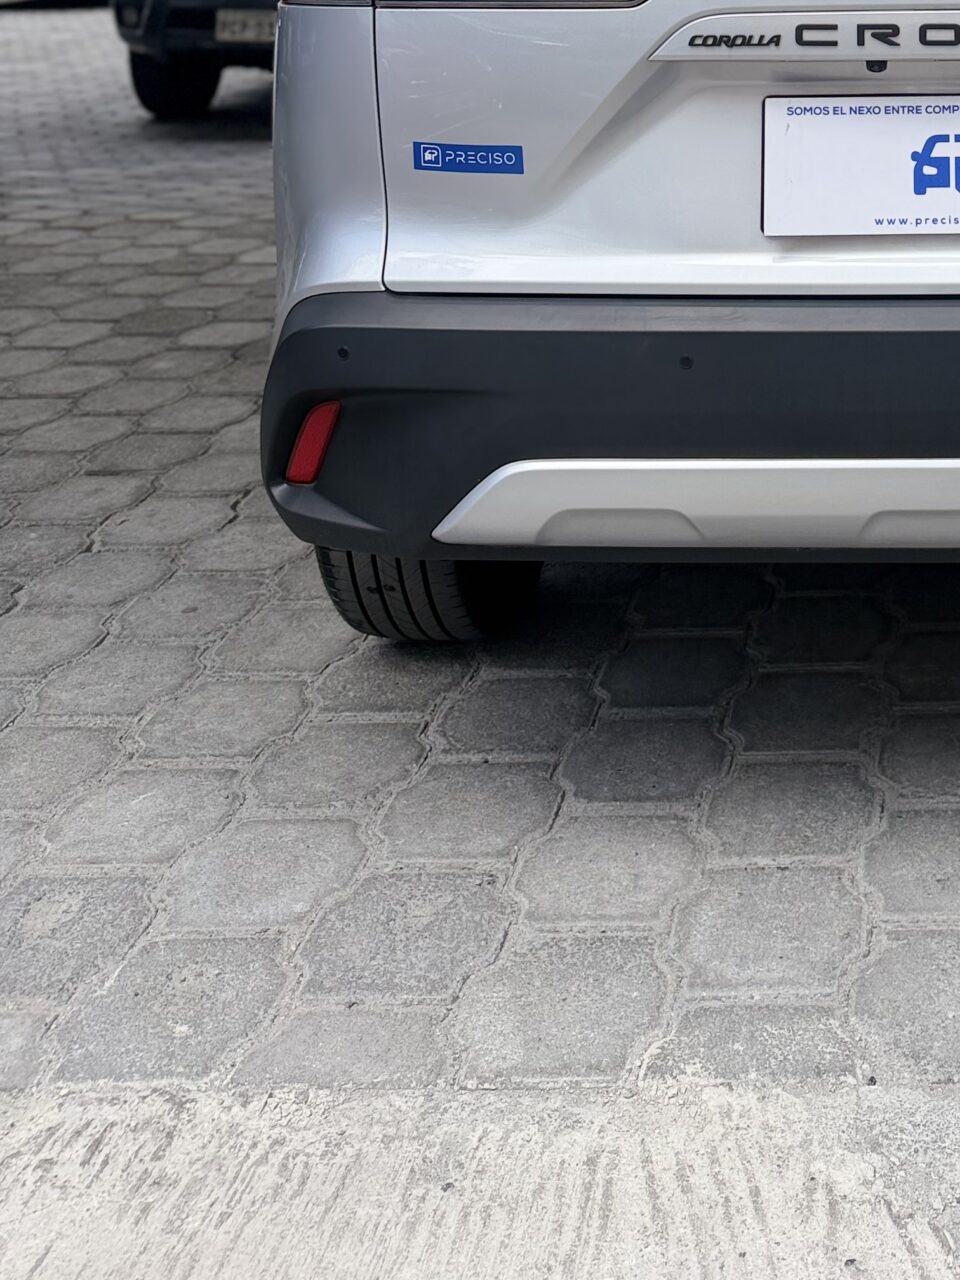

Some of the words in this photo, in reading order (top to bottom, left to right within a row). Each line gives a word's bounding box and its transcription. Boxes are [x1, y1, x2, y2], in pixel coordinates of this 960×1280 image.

[688, 33, 782, 48] COROLLA
[786, 106, 830, 116] SOMOS
[832, 106, 847, 115] EL
[849, 105, 882, 115] NEXO
[884, 105, 923, 115] ENTRE
[445, 150, 516, 165] PRECISO
